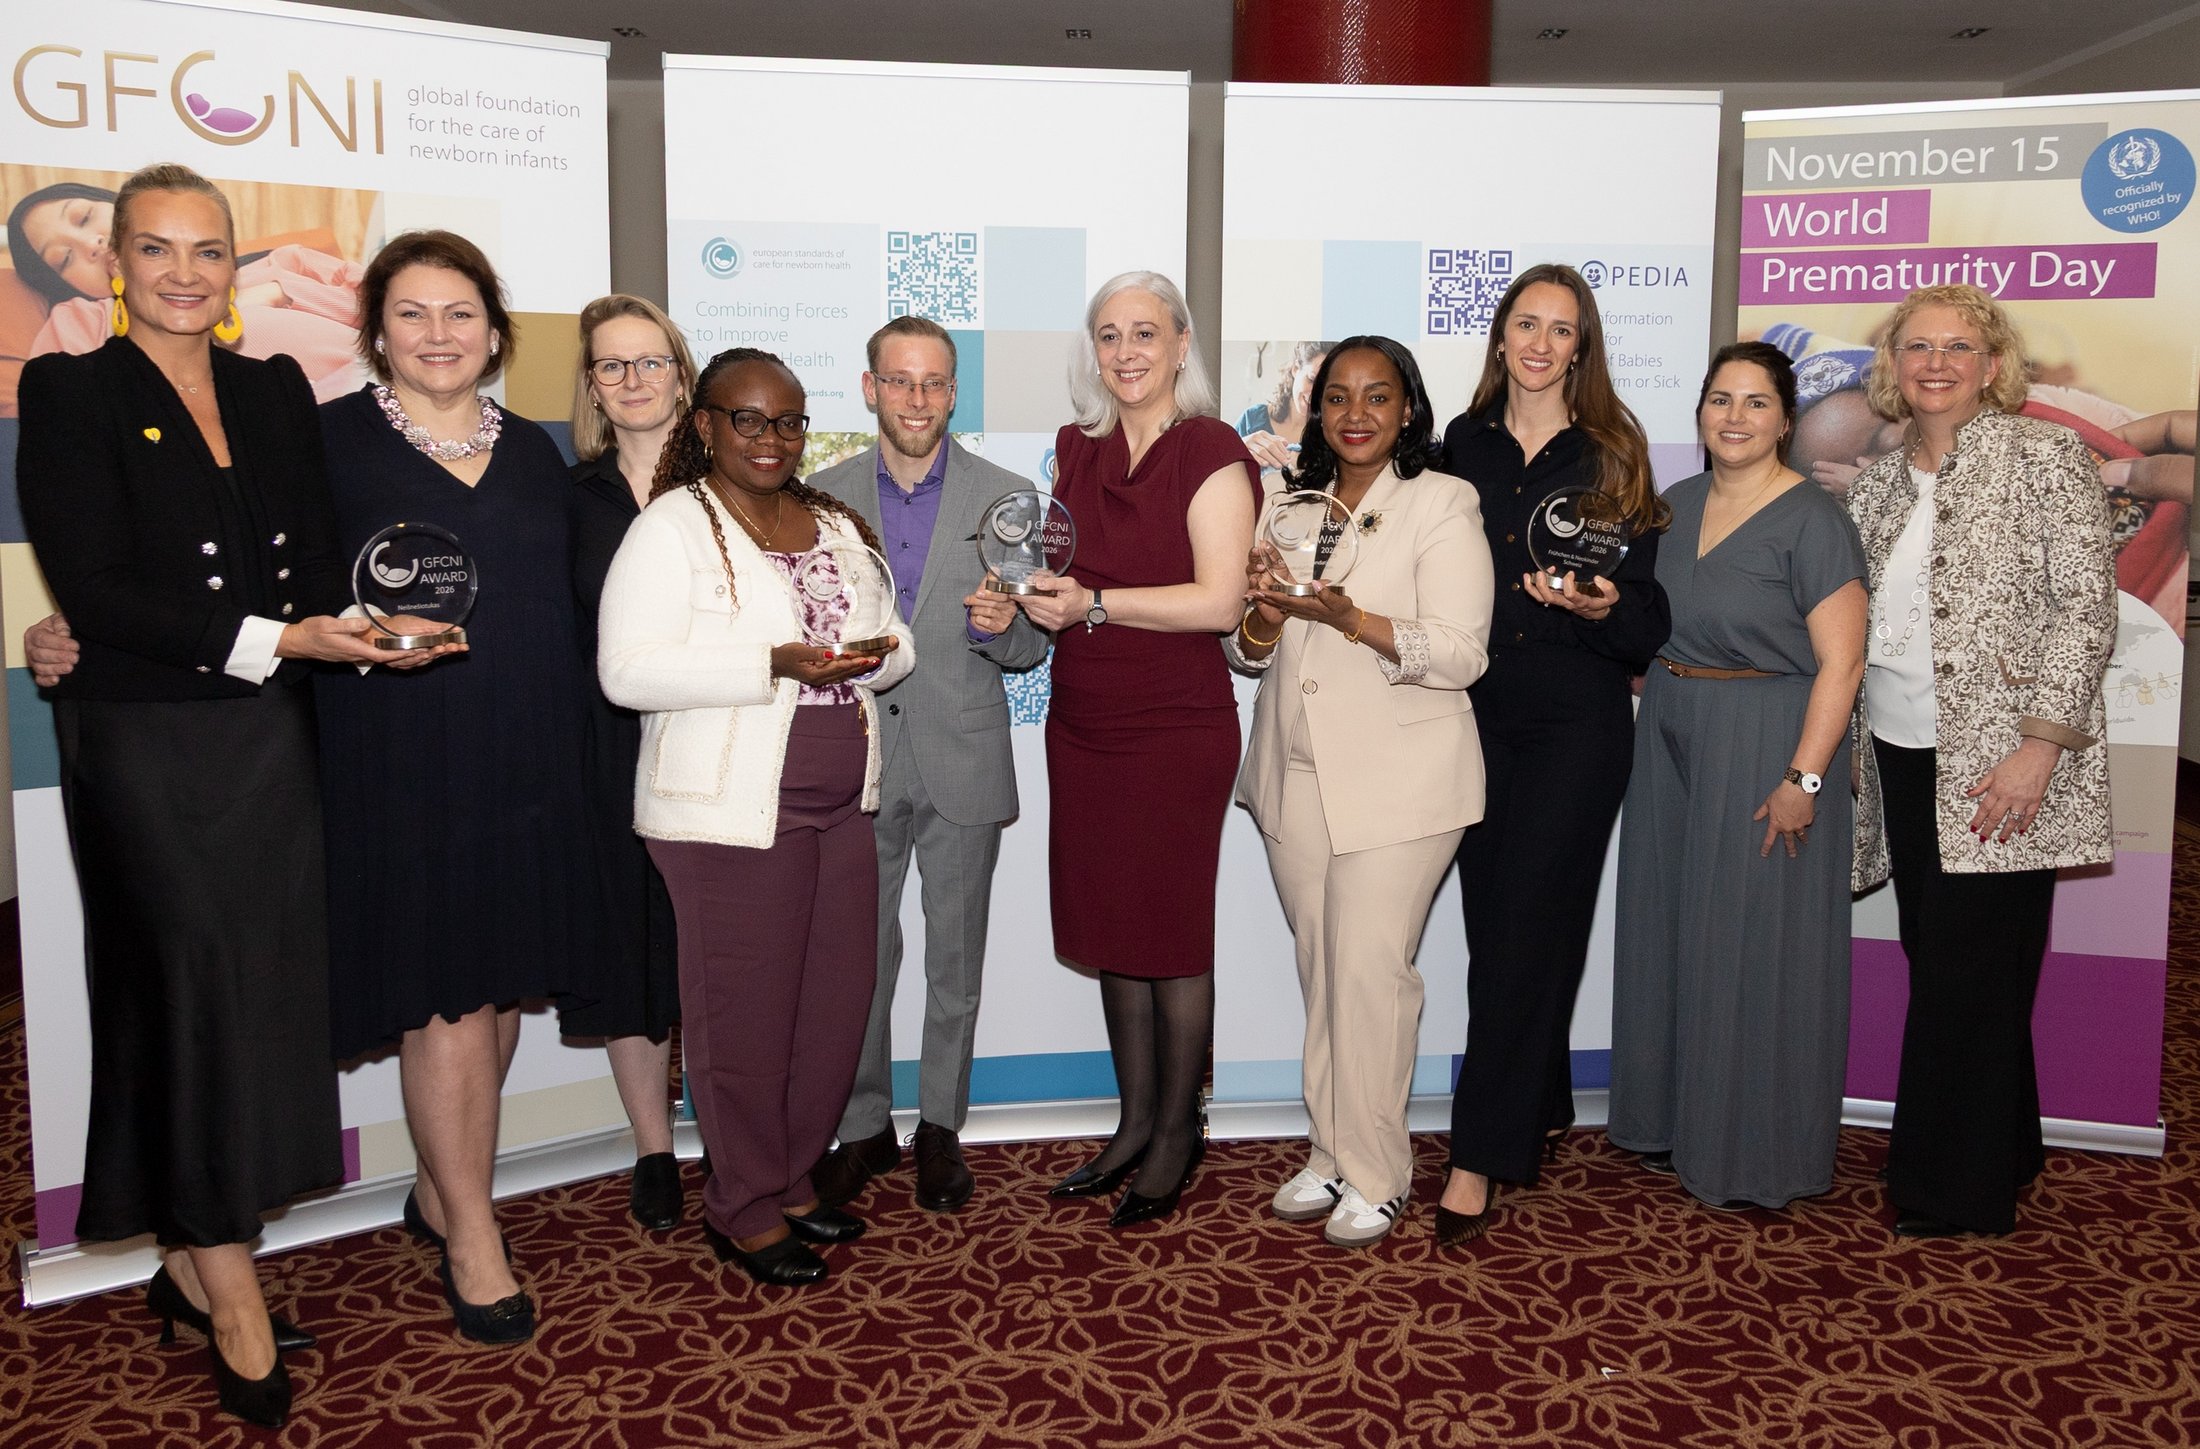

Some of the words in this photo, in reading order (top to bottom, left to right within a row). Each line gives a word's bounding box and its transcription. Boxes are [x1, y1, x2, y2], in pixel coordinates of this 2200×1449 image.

[13, 43, 385, 156] GFCNI
[407, 85, 469, 106] global
[475, 90, 581, 118] foundation
[408, 112, 435, 132] for
[441, 117, 474, 136] the
[480, 124, 520, 141] care
[526, 125, 546, 142] of
[409, 144, 498, 165] newborn
[505, 149, 568, 171] infants
[1766, 138, 1994, 182] November
[2011, 136, 2060, 172] 15
[2115, 181, 2164, 199] Officially
[2103, 194, 2164, 216] recognized
[2167, 193, 2182, 204] by
[1763, 197, 1888, 238] World
[2126, 210, 2161, 225] WHO!
[752, 249, 793, 259] european
[794, 249, 834, 258] standards
[835, 249, 845, 258] of
[752, 261, 771, 269] care
[772, 260, 784, 269] for
[785, 260, 824, 269] newborn
[825, 261, 852, 270] health
[1762, 253, 2016, 298] Prematurity
[2029, 251, 2116, 297] Day
[695, 301, 790, 322] Combining
[796, 302, 849, 319] Forces
[696, 328, 714, 342] to
[719, 326, 789, 345] Improve
[1604, 331, 1623, 346] for
[781, 351, 835, 367] Health
[1618, 353, 1663, 367] Babies
[1635, 378, 1650, 388] or
[1654, 374, 1681, 389] Sick
[1034, 521, 1069, 532] GFCNI
[1587, 518, 1621, 534] GFCNI
[1030, 534, 1070, 546] AWARD
[1580, 531, 1621, 547] AWARD
[1041, 546, 1058, 554] 2026
[1590, 546, 1607, 554] 2026
[422, 555, 463, 569] GFCNI
[420, 571, 468, 584] AWARD
[435, 586, 455, 595] 2026
